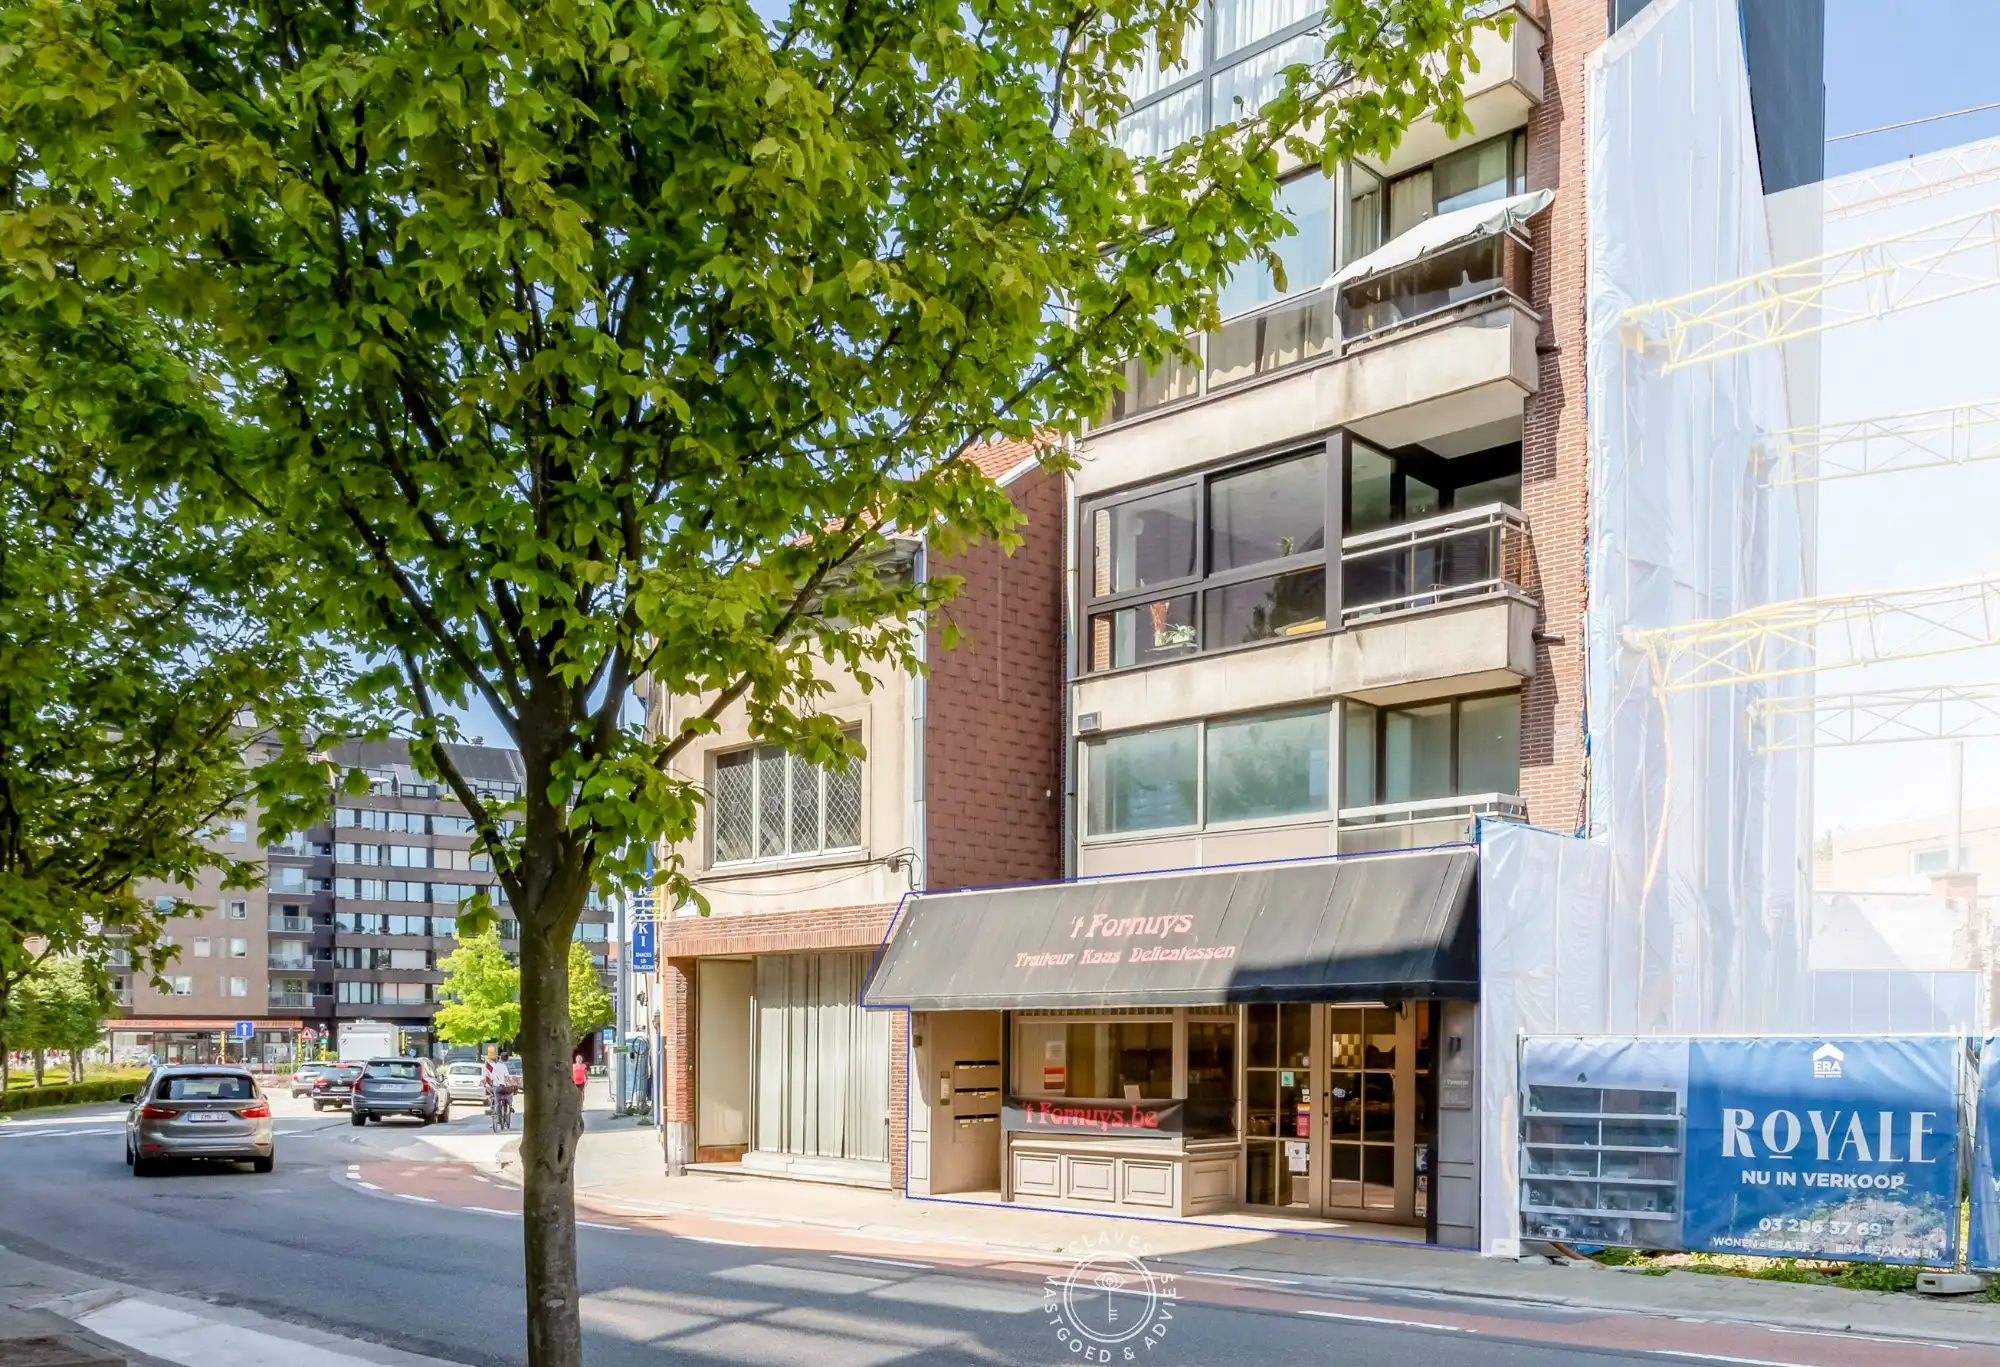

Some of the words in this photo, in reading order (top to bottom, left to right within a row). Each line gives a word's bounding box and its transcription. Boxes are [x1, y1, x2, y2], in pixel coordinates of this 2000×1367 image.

[1085, 913, 1194, 939] Fornuys
[1015, 952, 1075, 968] Traiteur
[1081, 949, 1122, 965] Kaas
[1128, 945, 1236, 963] Delicatessen
[1814, 1060, 1842, 1072] ERA
[1039, 1100, 1161, 1131] Fornuys.be
[1721, 1108, 1937, 1163] ROYALE
[1742, 1170, 1770, 1185] NU
[1776, 1171, 1796, 1186] IN
[1802, 1172, 1905, 1189] VERKOOP
[1758, 1217, 1783, 1232] 03
[1856, 1222, 1882, 1237] 69
